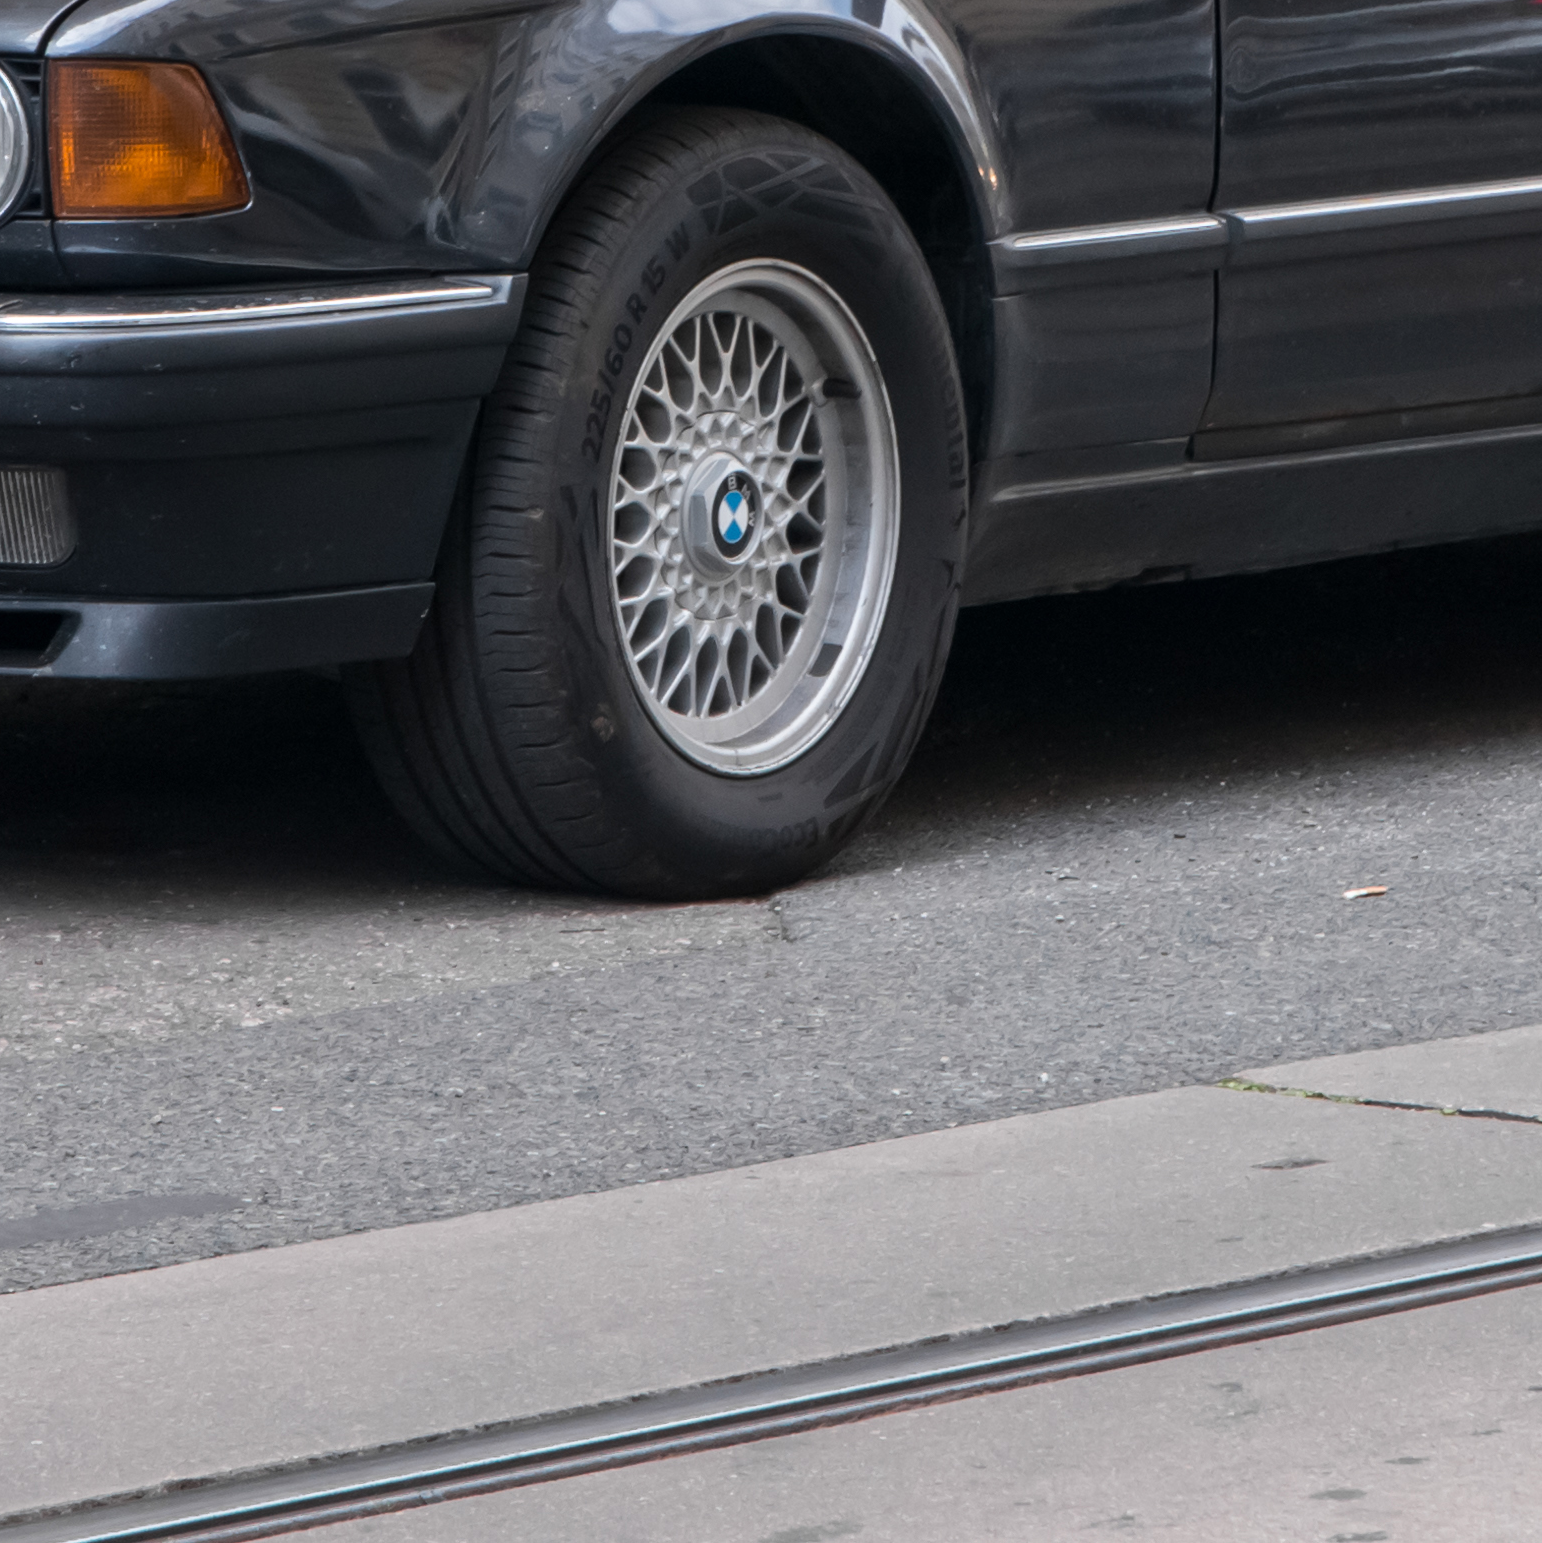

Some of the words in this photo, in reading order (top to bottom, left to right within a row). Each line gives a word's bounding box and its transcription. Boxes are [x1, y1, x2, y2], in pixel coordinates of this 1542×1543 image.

[580, 322, 633, 465] 225/60
[625, 292, 648, 326] R
[641, 254, 667, 296] 15
[664, 221, 691, 262] W
